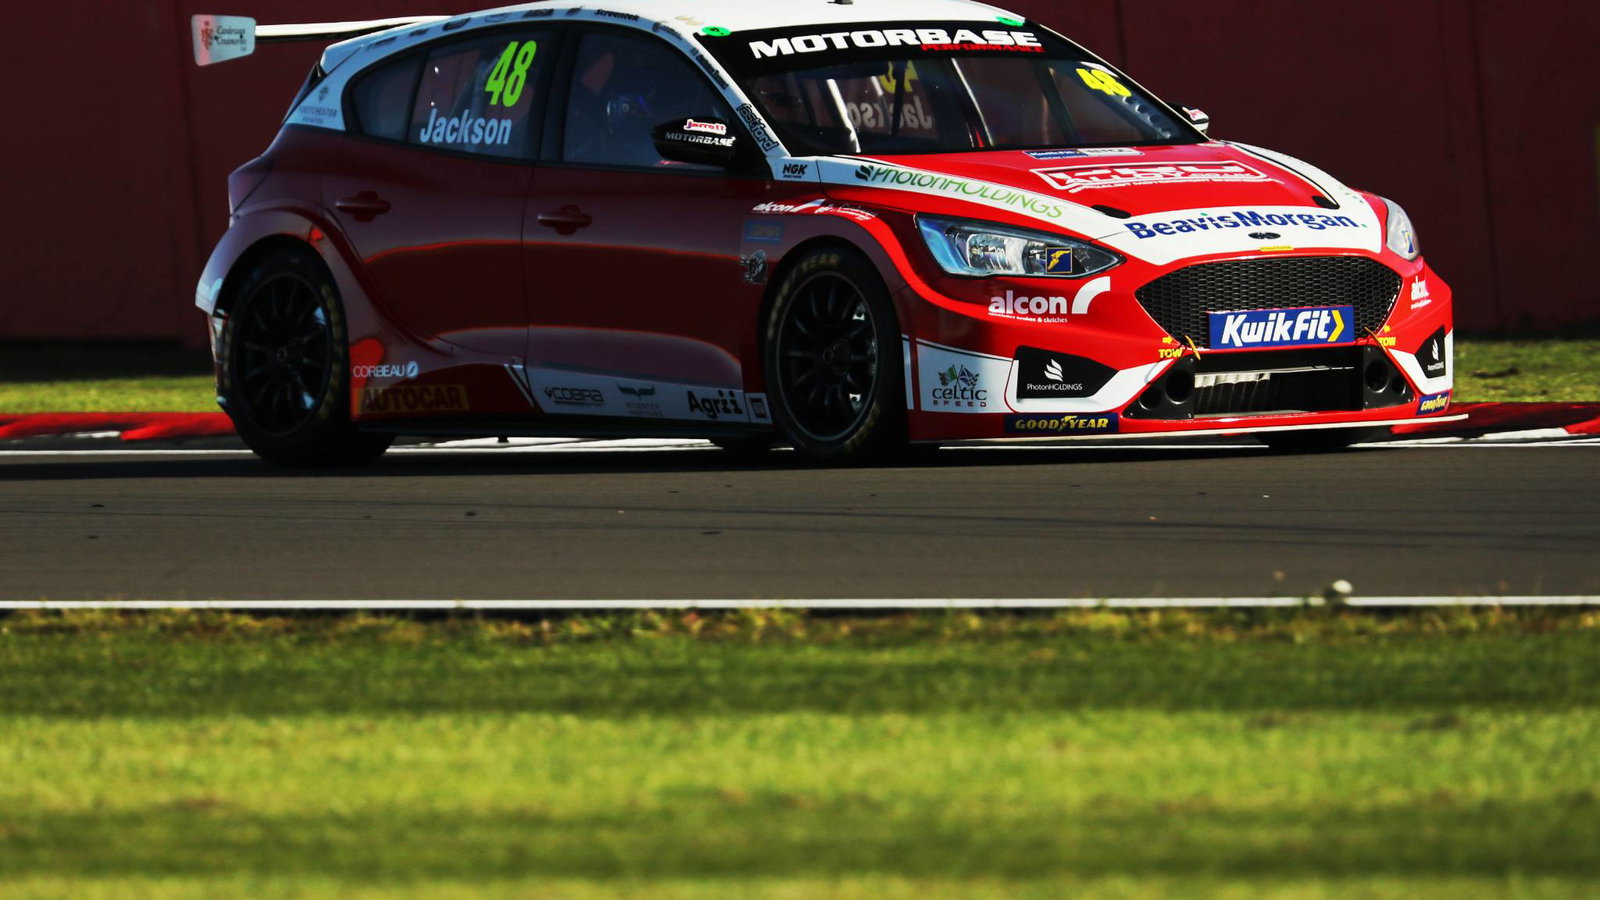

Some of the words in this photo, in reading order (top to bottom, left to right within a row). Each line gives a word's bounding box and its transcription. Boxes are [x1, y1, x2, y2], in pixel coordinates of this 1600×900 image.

[750, 28, 1041, 59] MOTORBASE
[921, 42, 1045, 53] PERFORMANCE
[484, 40, 537, 107] 48
[1076, 67, 1132, 97] 48
[420, 107, 512, 145] Jackson
[665, 132, 734, 147] MOTORBASE
[782, 163, 808, 175] NGK
[988, 289, 1068, 315] alcon
[1377, 336, 1396, 347] TOW
[1158, 346, 1184, 358] TOW
[352, 364, 405, 378] CORBEAU
[1026, 383, 1083, 391] PhotonHOLDINGS
[365, 386, 462, 411] AUTOCAR
[687, 389, 743, 419] Agrii
[932, 400, 987, 408] SPEED
